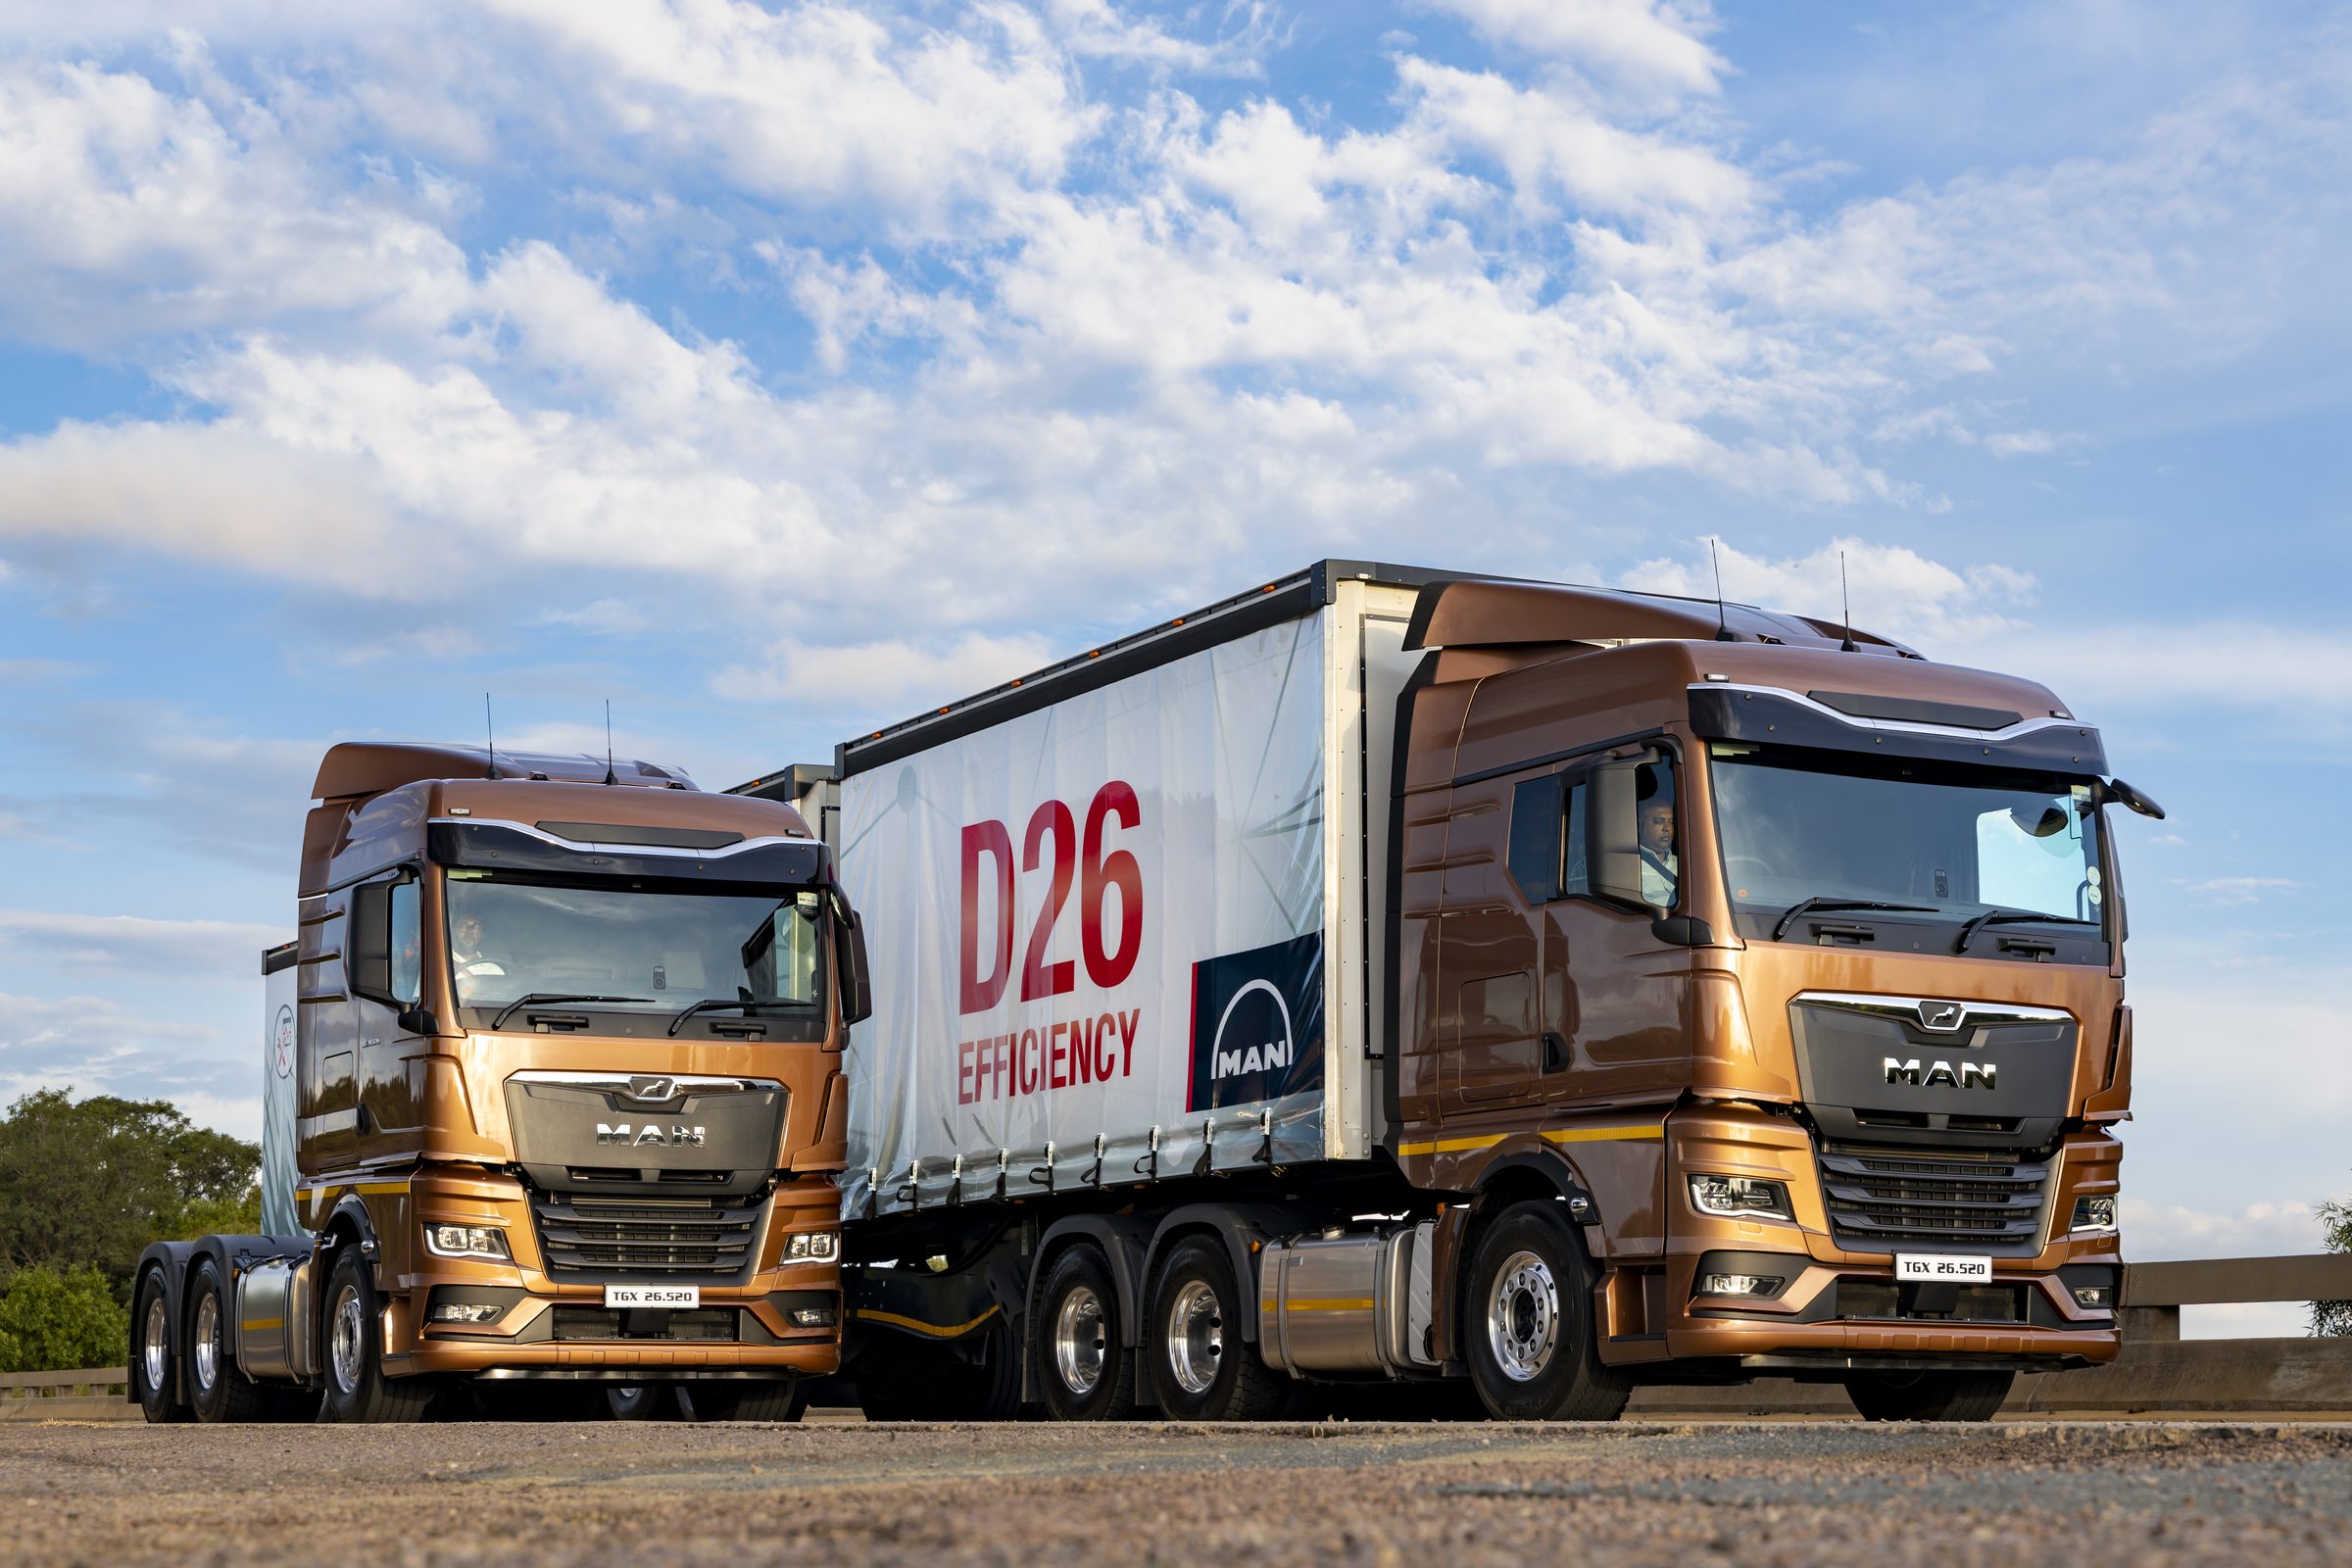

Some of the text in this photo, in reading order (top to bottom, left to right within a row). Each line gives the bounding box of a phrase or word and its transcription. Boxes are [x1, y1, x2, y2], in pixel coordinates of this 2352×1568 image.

[959, 780, 1143, 1015] D26
[958, 1008, 1141, 1105] EFFICIENCY
[1218, 1040, 1286, 1079] MAN
[1885, 1057, 1996, 1090] MAN
[596, 1123, 706, 1149] MAN
[1904, 1261, 1985, 1275] TGX 26.520
[613, 1292, 692, 1301] TGX 26.520
